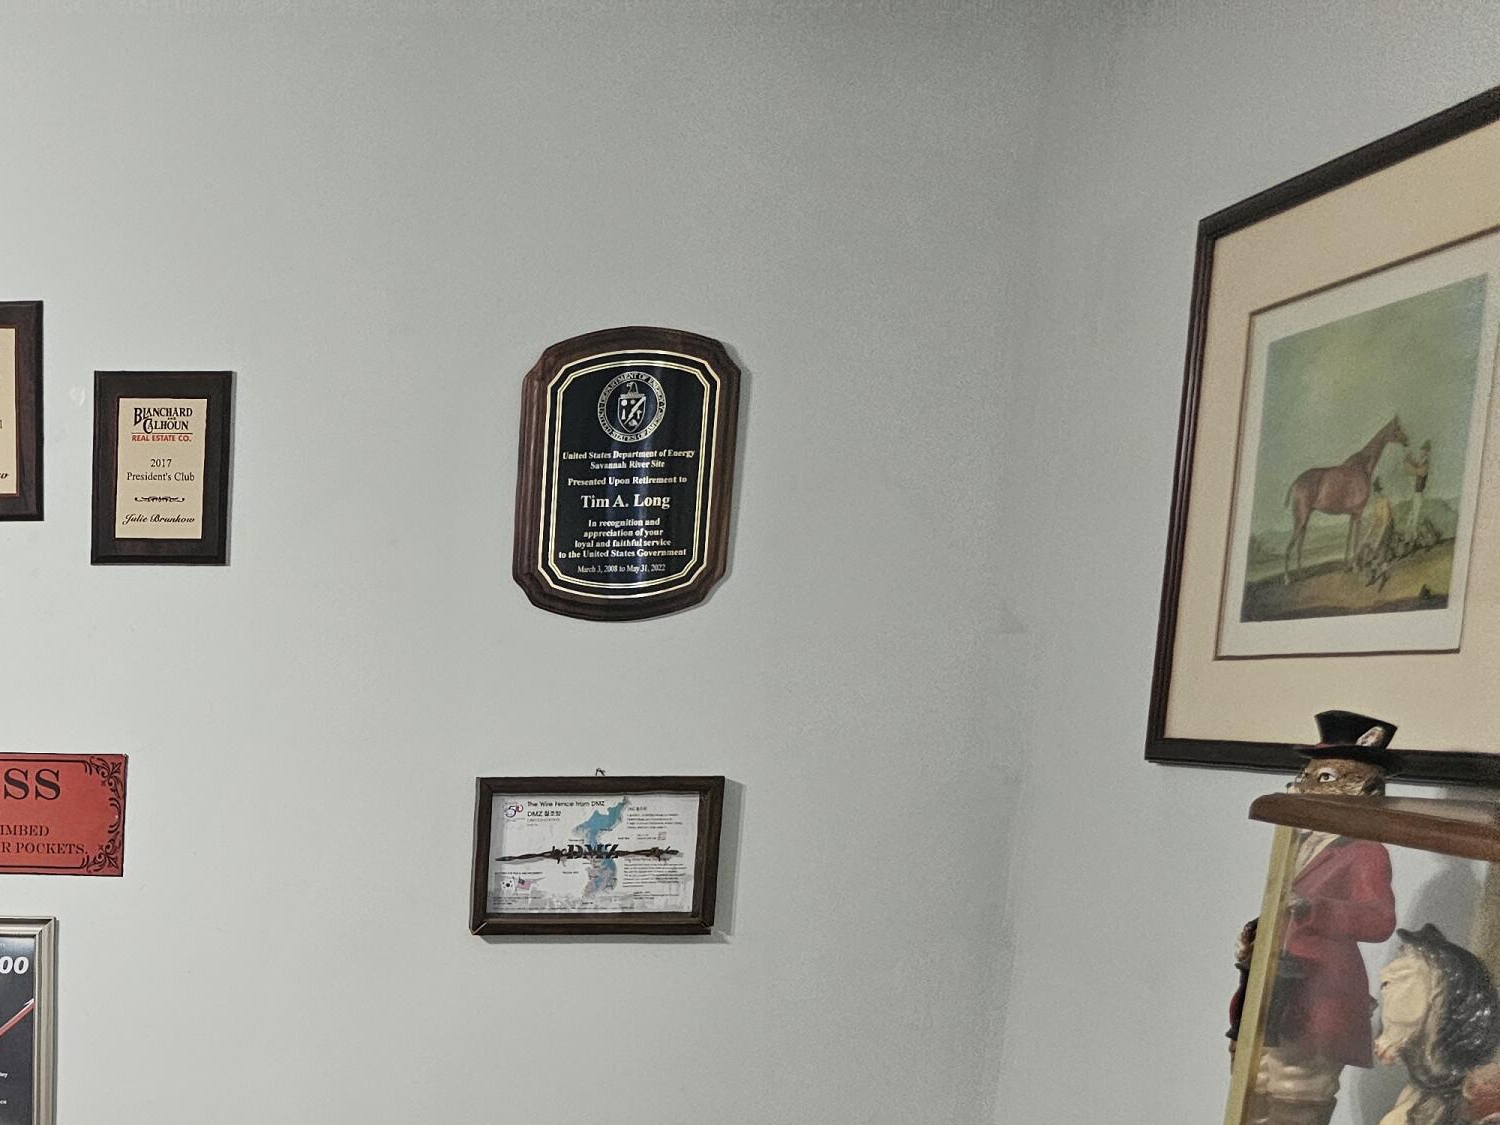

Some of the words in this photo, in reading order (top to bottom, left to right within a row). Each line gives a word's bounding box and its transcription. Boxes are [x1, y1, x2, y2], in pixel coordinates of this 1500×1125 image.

[134, 408, 192, 426] BLANCHARD
[143, 418, 188, 434] CALHOUN
[562, 452, 587, 460] United
[613, 450, 656, 460] Department
[668, 449, 695, 458] Energy
[151, 459, 172, 468] 2017
[590, 461, 626, 469] Savannah
[629, 460, 650, 468] River
[651, 460, 665, 468] Site
[126, 472, 172, 480] President's
[174, 472, 194, 481] Club
[568, 478, 606, 486] Presented
[608, 477, 630, 486] Upon
[632, 476, 676, 484] Retirement
[581, 495, 610, 508] Tim
[612, 494, 629, 508] A.
[634, 494, 670, 510] Long
[122, 514, 147, 525] Julie
[150, 514, 195, 522] Brunkow
[599, 519, 644, 528] recognition
[645, 518, 660, 526] and
[583, 528, 633, 538] appreciation
[635, 528, 644, 536] of
[644, 530, 664, 538] your
[575, 540, 594, 550] loyal
[596, 540, 610, 548] and
[612, 539, 642, 547] faithful
[568, 550, 580, 558] the
[583, 550, 609, 558] United
[637, 548, 686, 556] Government
[627, 564, 640, 574] May
[652, 564, 666, 572] 2022
[16, 842, 89, 856] POCKETS.
